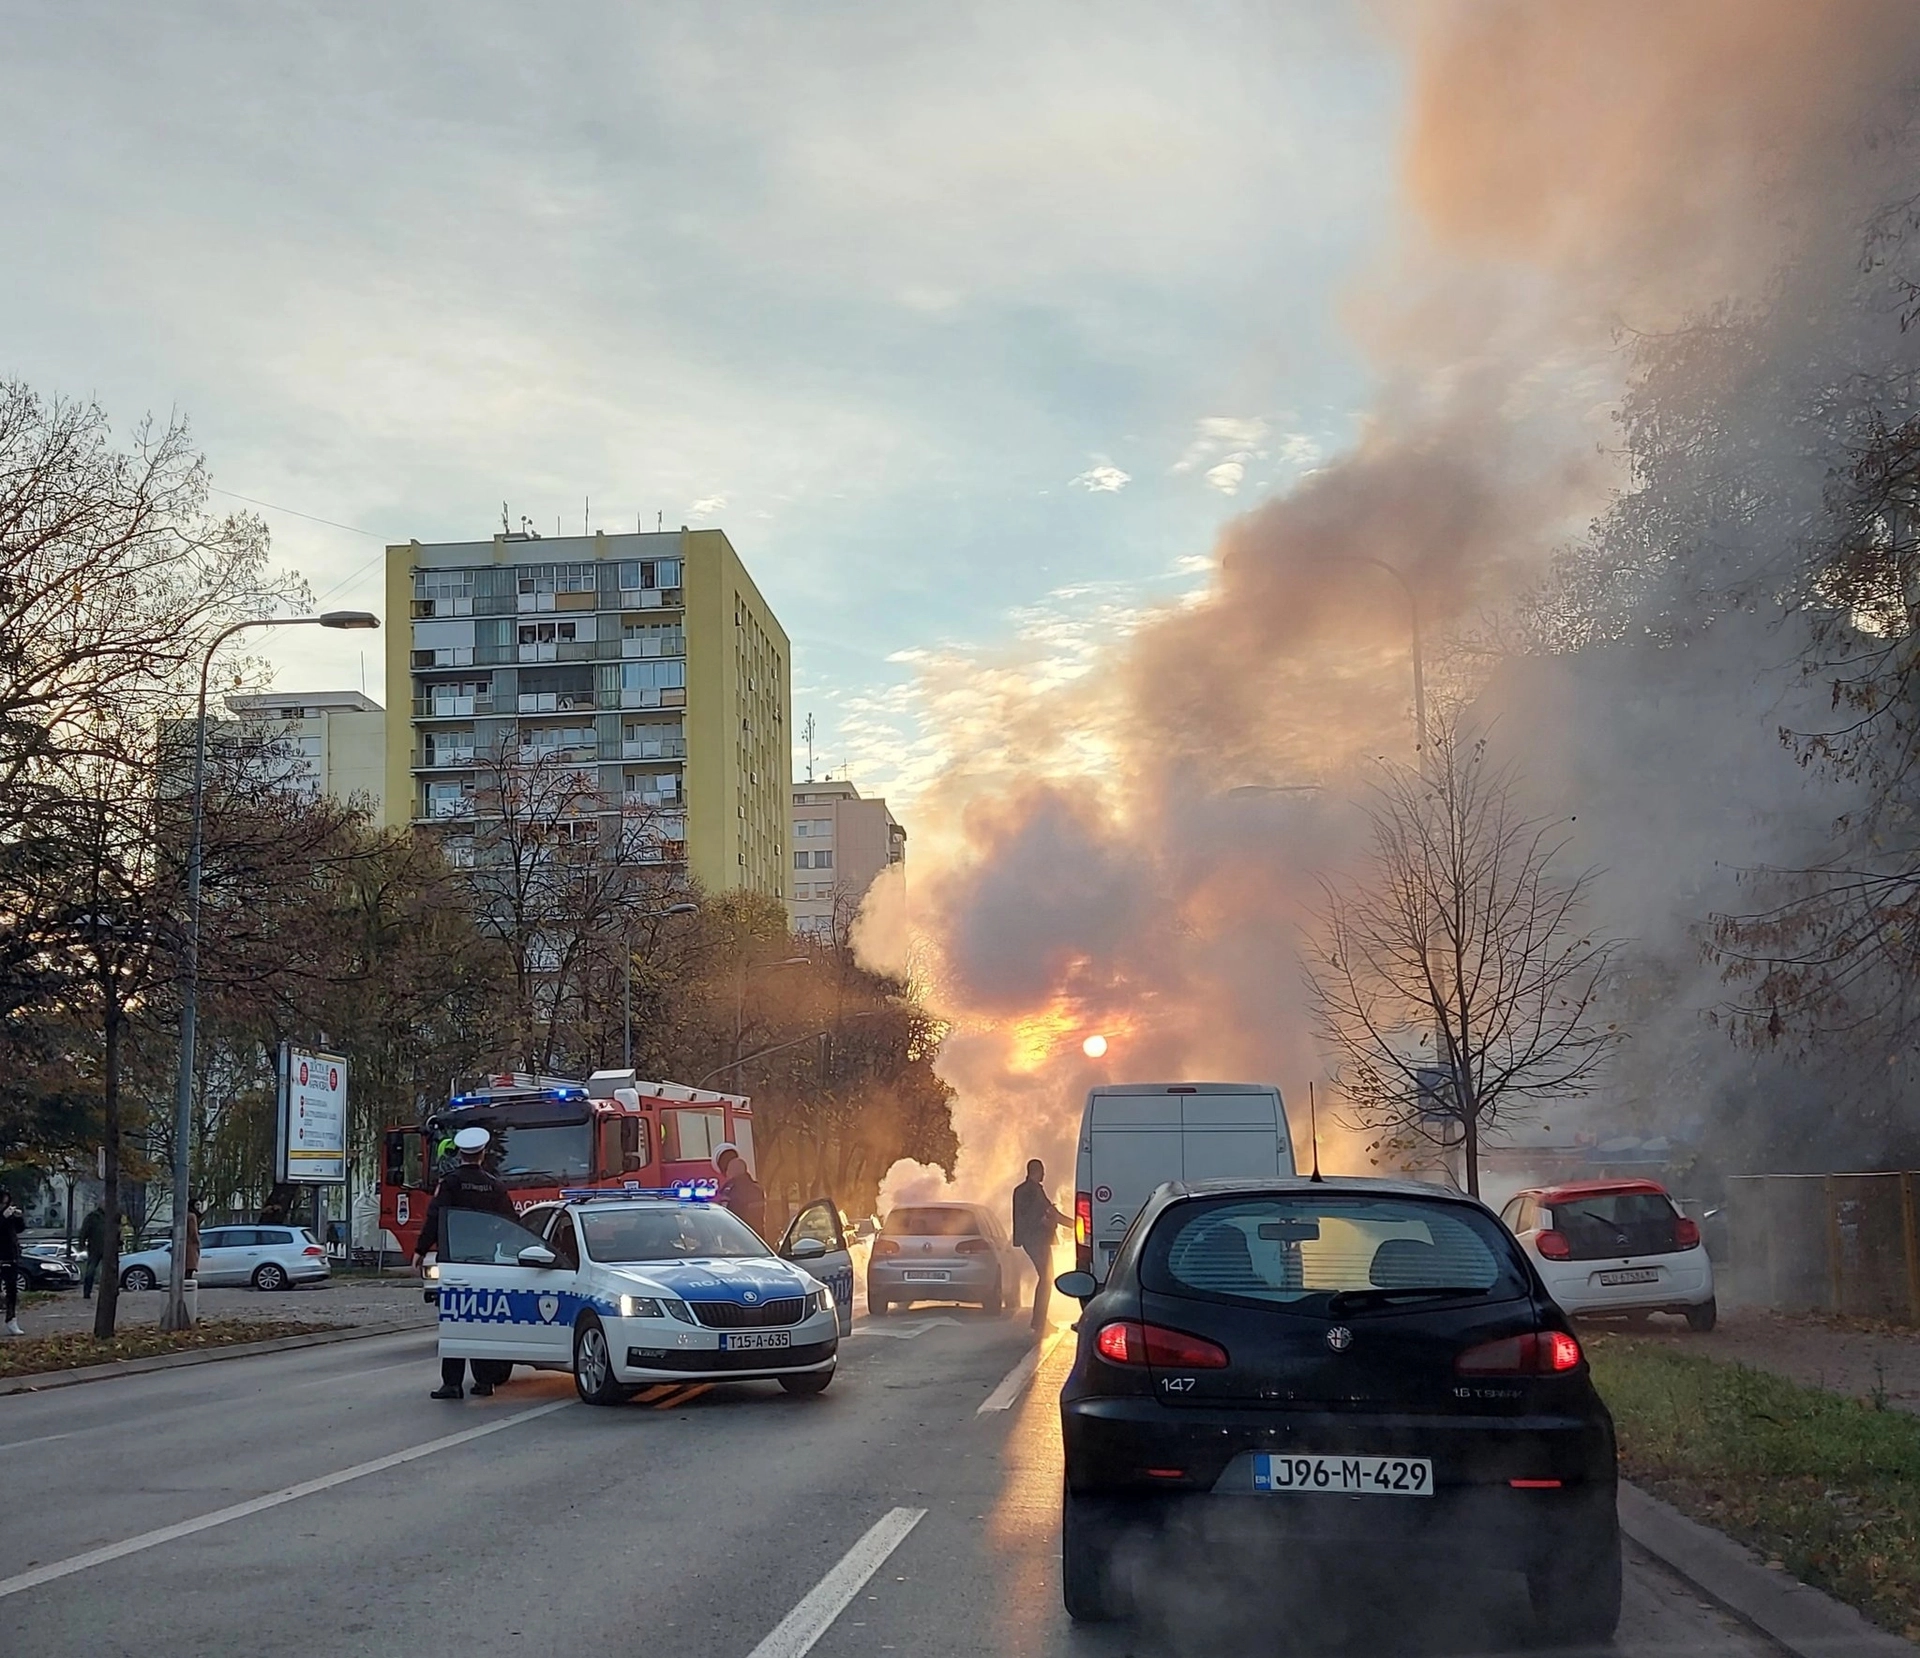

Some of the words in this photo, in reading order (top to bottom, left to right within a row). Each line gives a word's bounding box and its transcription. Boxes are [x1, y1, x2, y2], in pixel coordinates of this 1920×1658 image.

[1099, 1190, 1109, 1198] 80
[440, 1293, 511, 1319] ЦИЈА
[729, 1334, 788, 1348] T15-A-635
[1161, 1378, 1196, 1392] 147
[1276, 1459, 1427, 1490] J96-M-429
